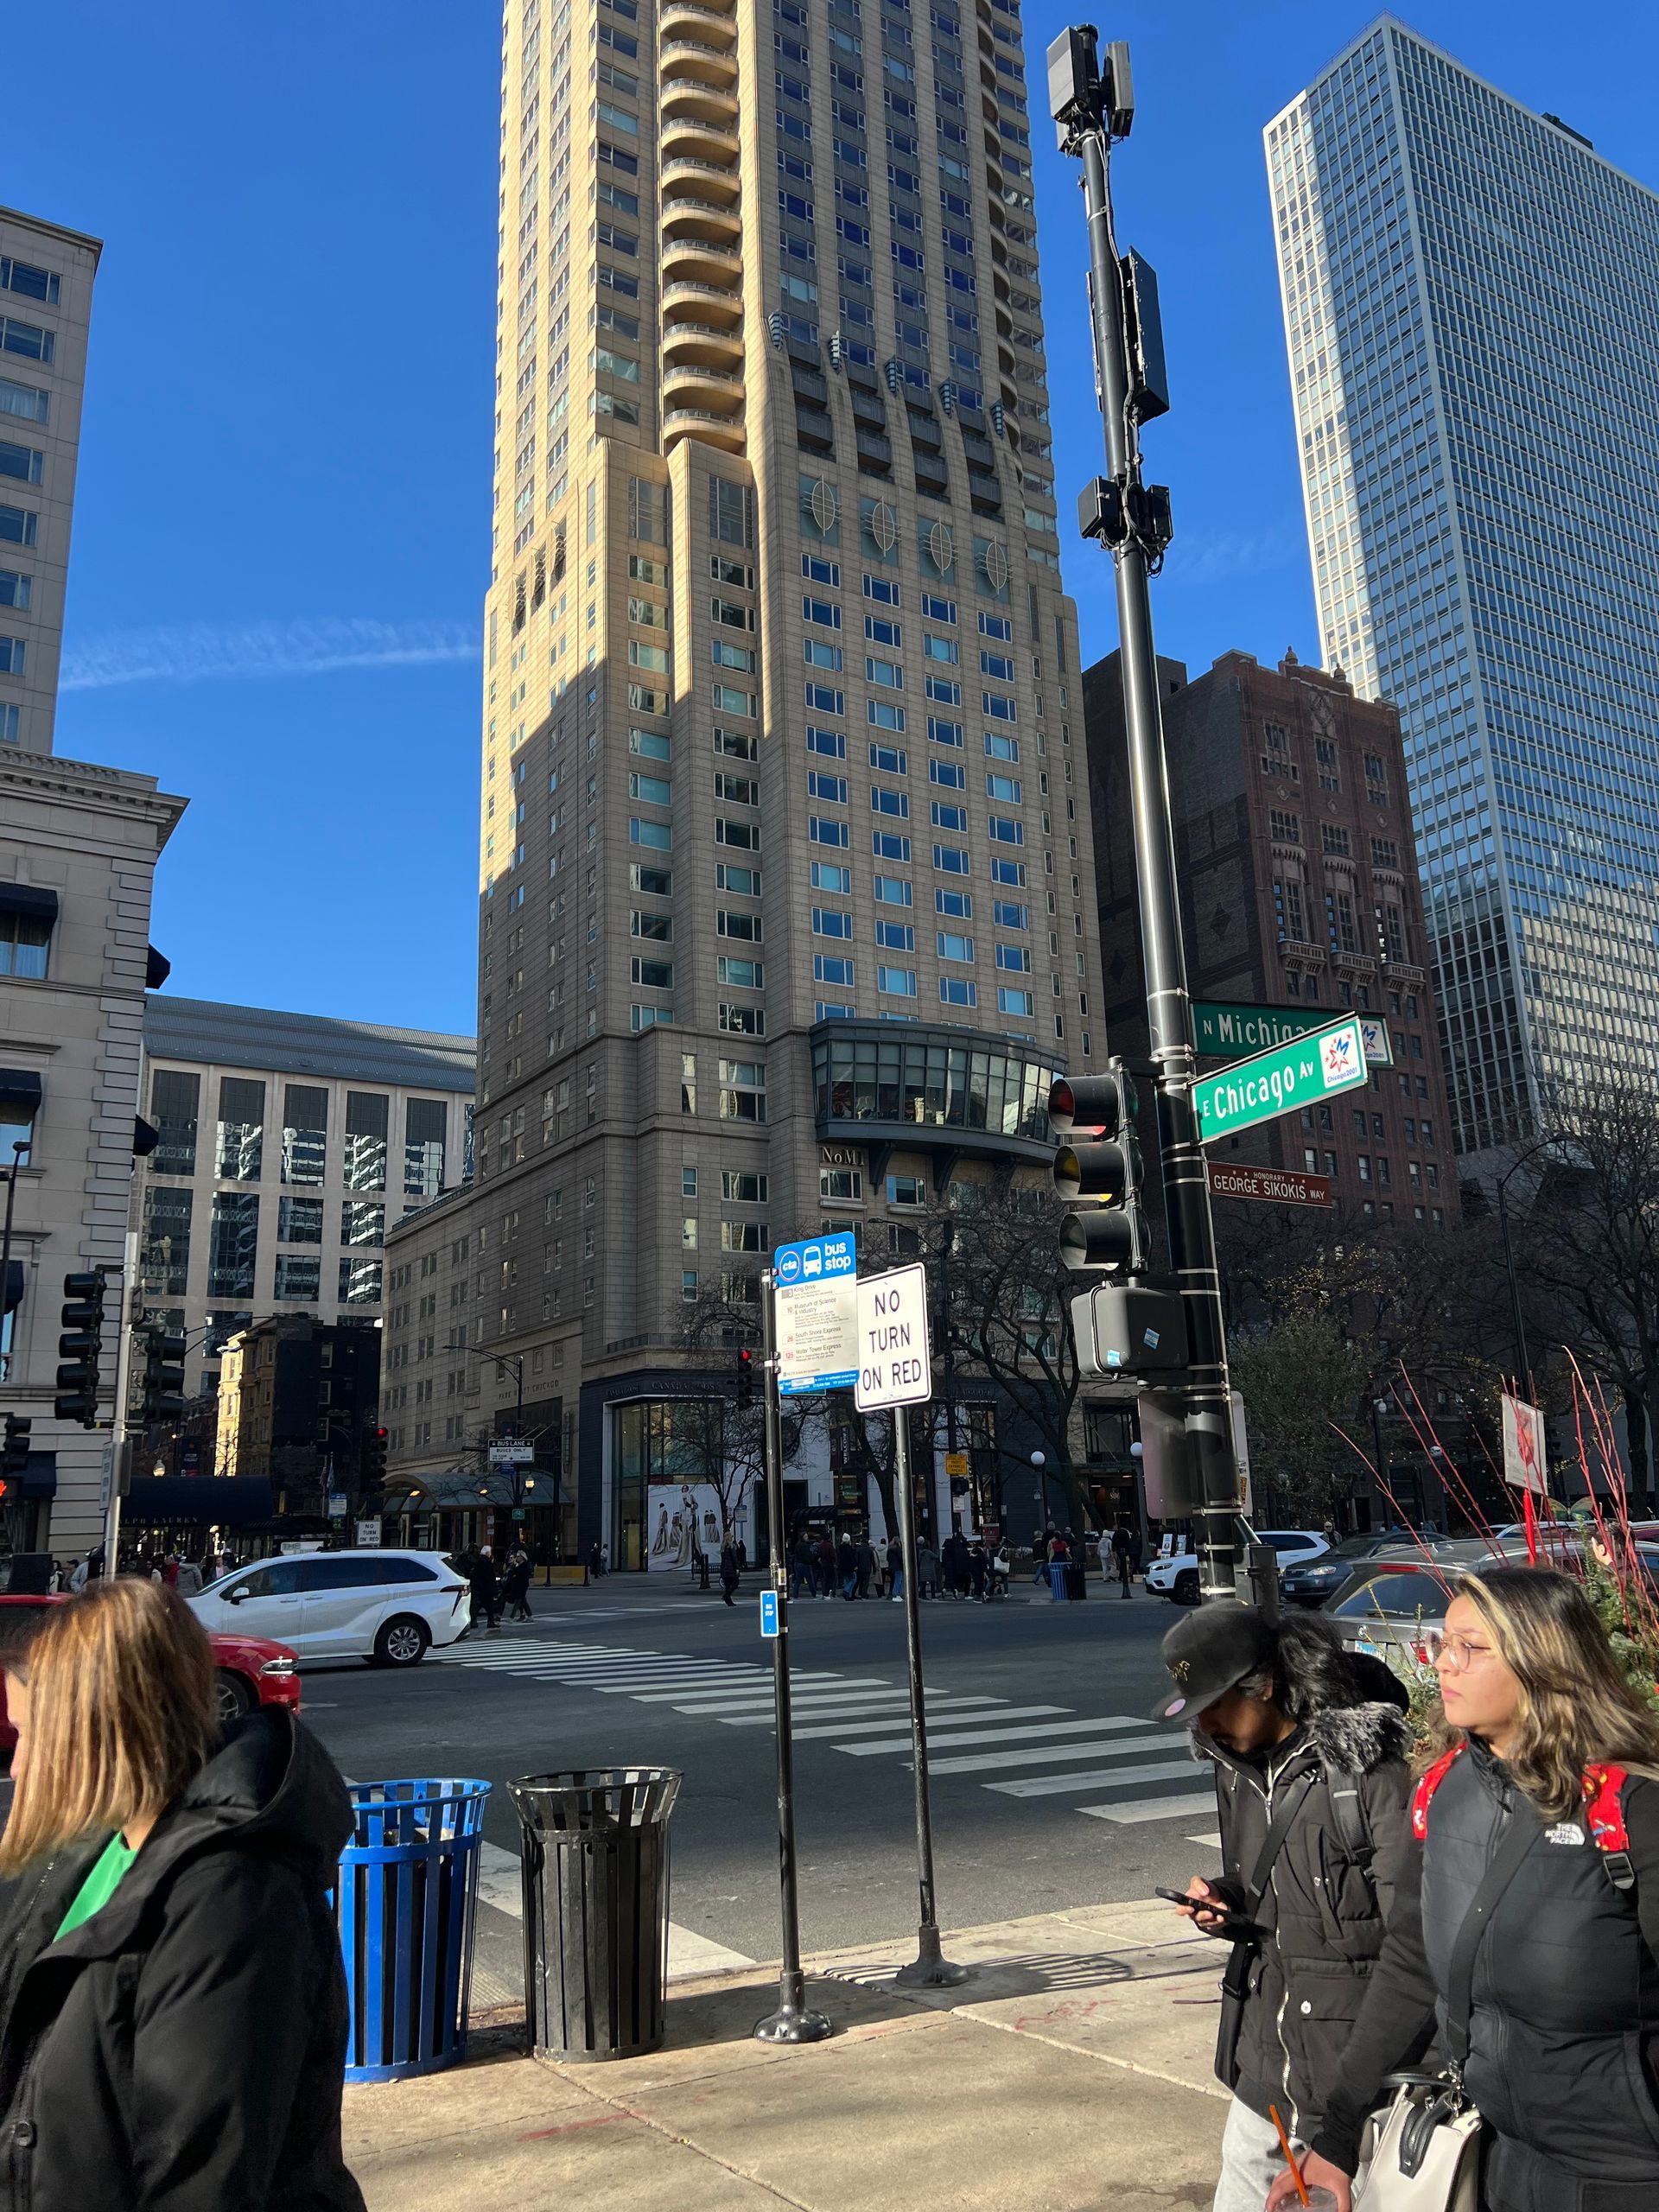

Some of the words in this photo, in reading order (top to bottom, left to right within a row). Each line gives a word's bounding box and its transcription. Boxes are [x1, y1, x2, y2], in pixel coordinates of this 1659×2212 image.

[1203, 1020, 1213, 1035] N
[1203, 1099, 1210, 1117] E
[1214, 1065, 1295, 1119] Chicago
[1300, 1061, 1313, 1080] Av
[1253, 1171, 1285, 1182] HONORARY
[1213, 1174, 1259, 1194] GEORGE
[1263, 1180, 1306, 1200] SIKOKIS
[1309, 1189, 1325, 1200] WAY
[824, 1243, 847, 1257] bus
[783, 1260, 798, 1271] cta
[824, 1255, 851, 1271] stop
[874, 1289, 900, 1317] NO
[868, 1322, 911, 1354] TURN
[862, 1365, 882, 1391] ON
[892, 1358, 921, 1387] RED
[1556, 1822, 1573, 1831] THE
